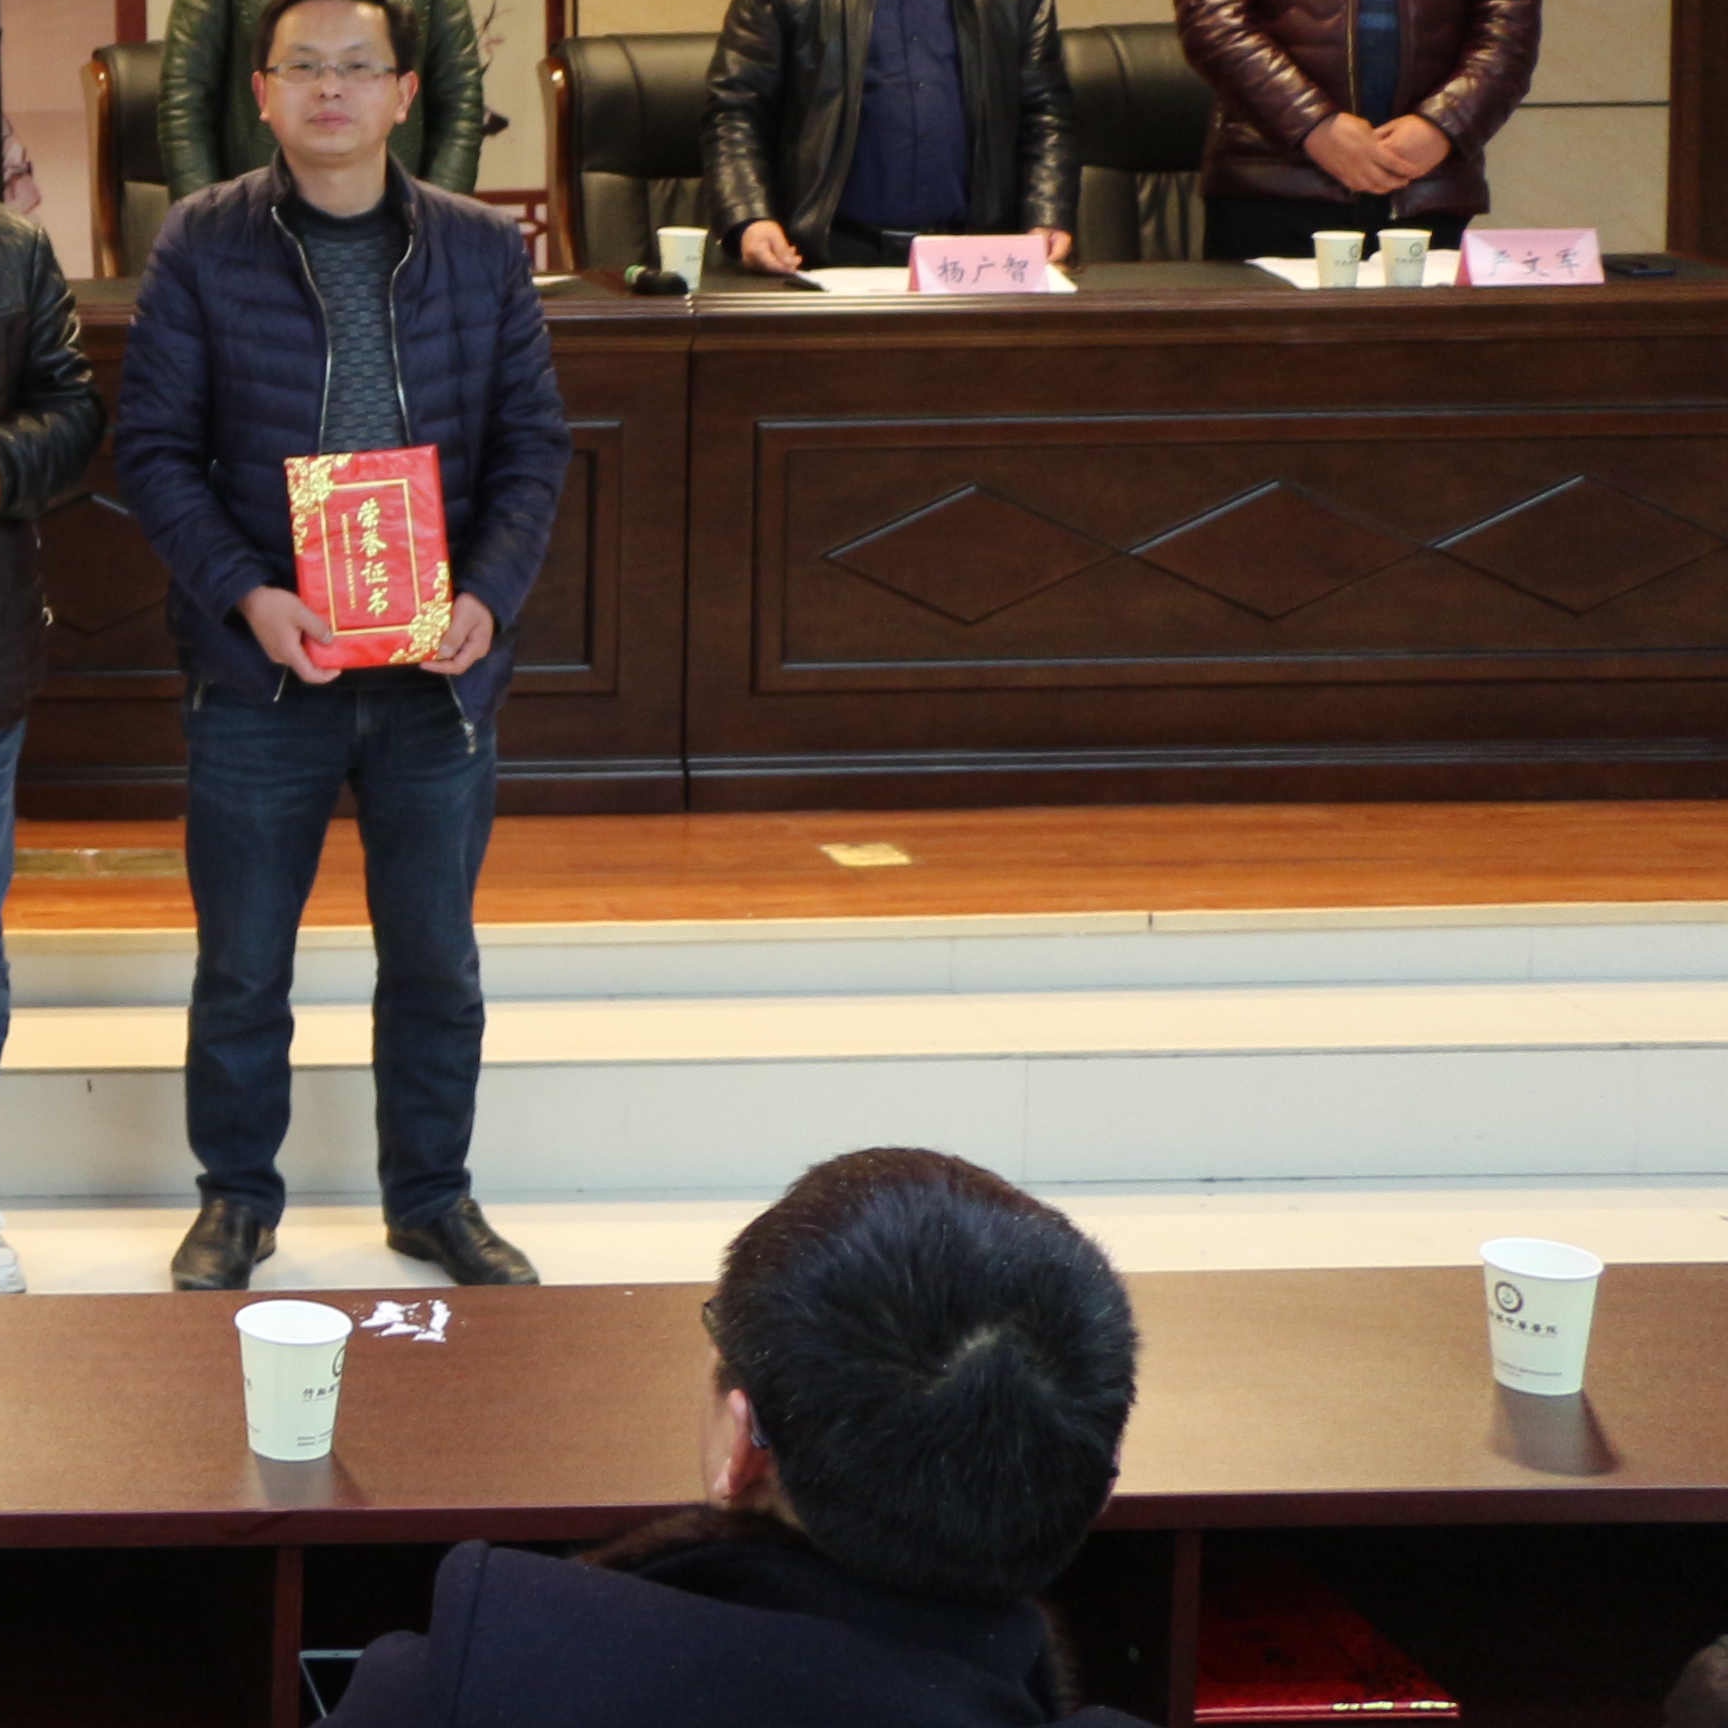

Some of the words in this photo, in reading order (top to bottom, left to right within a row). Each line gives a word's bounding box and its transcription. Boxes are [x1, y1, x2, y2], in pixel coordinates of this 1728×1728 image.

[938, 255, 1029, 283] 杨广智
[358, 496, 389, 618] 荣誉证书
